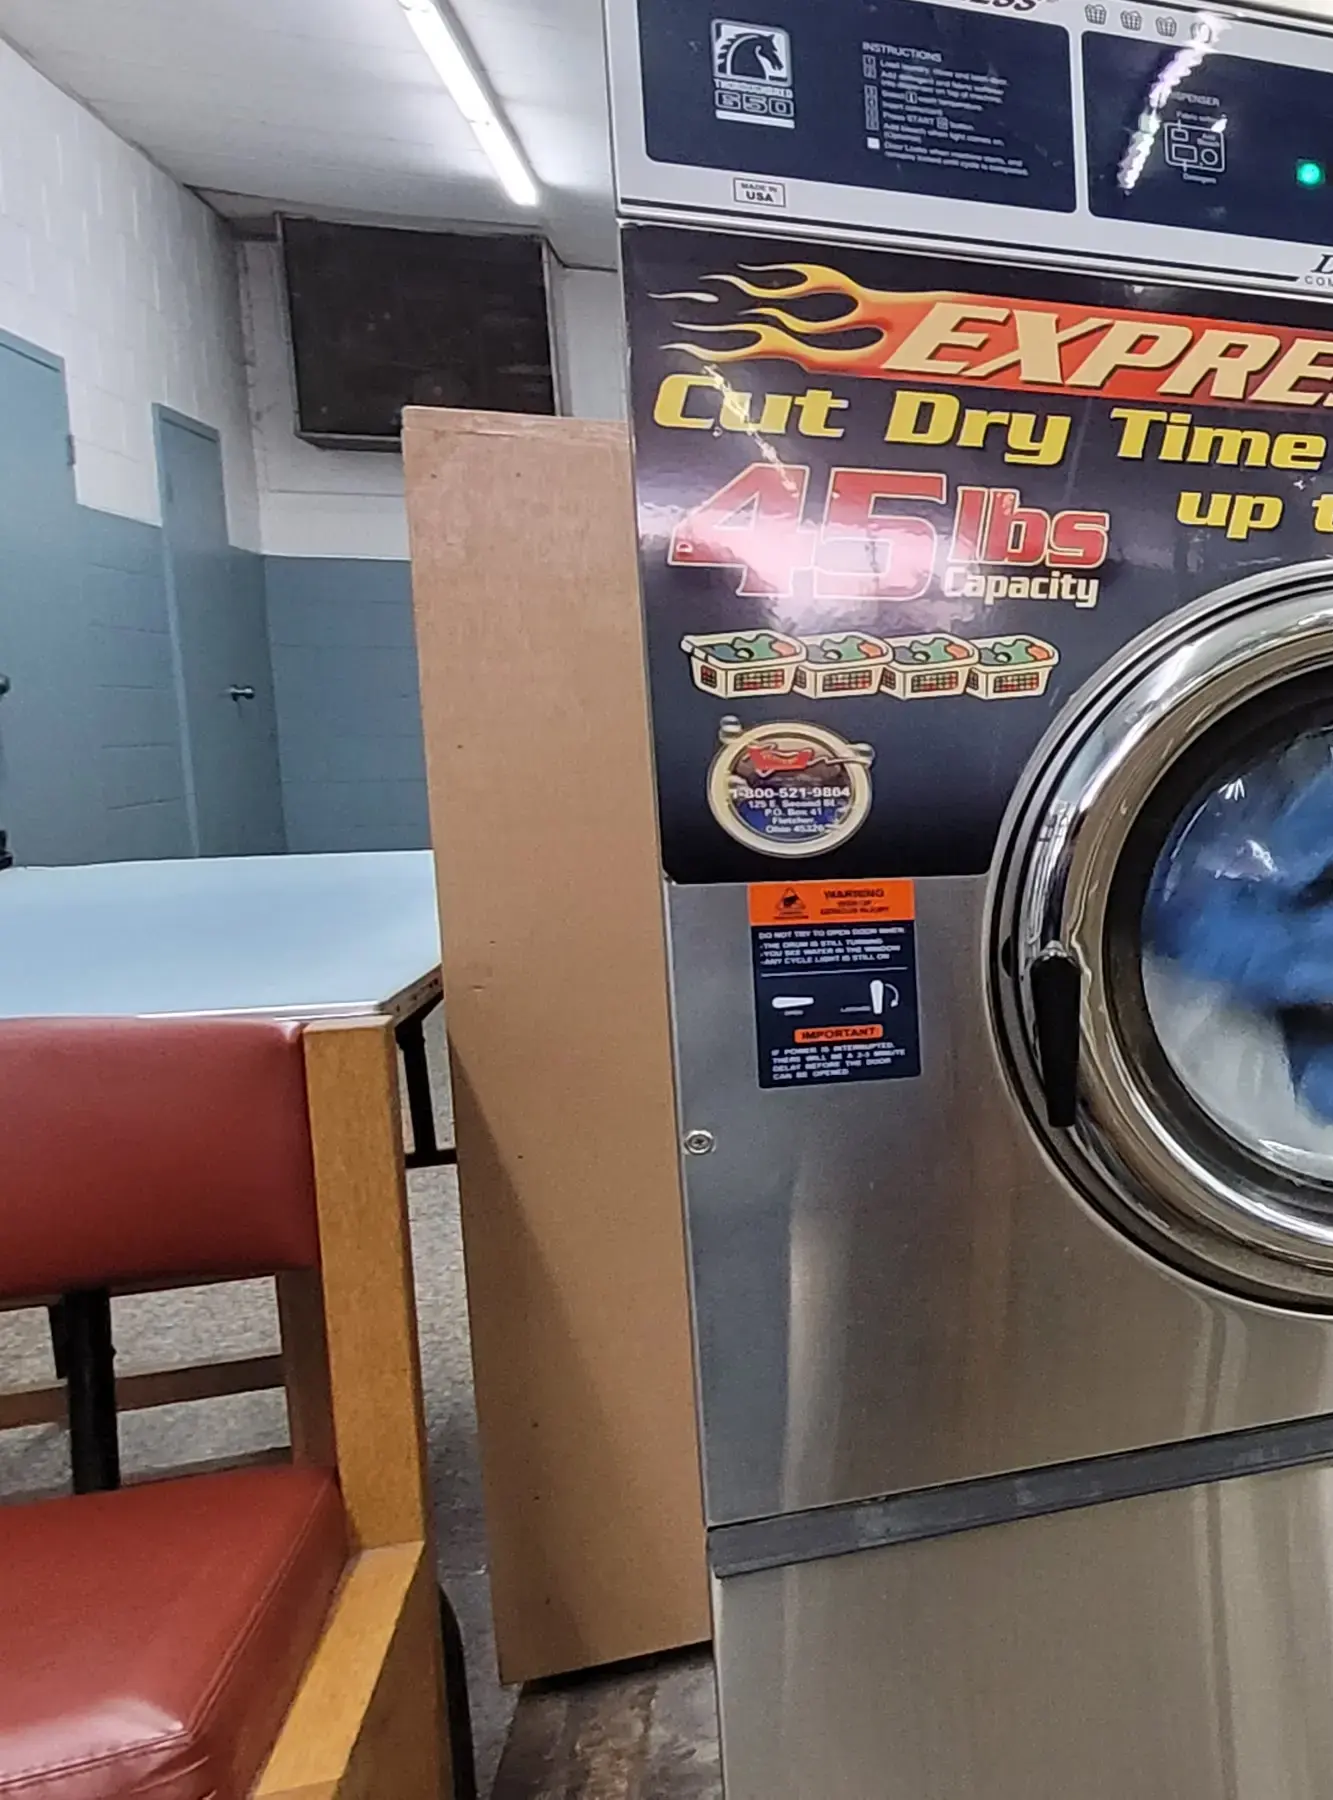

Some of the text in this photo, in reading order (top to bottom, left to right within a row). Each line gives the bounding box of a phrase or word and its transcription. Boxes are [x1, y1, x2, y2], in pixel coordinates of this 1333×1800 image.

[746, 191, 774, 202] USA
[652, 373, 1328, 471] Cut Dry Time
[667, 461, 1112, 602] 45 lbs
[1175, 489, 1283, 540] up
[944, 565, 1100, 609] Capacity
[801, 1026, 876, 1040] IMPORTANT
